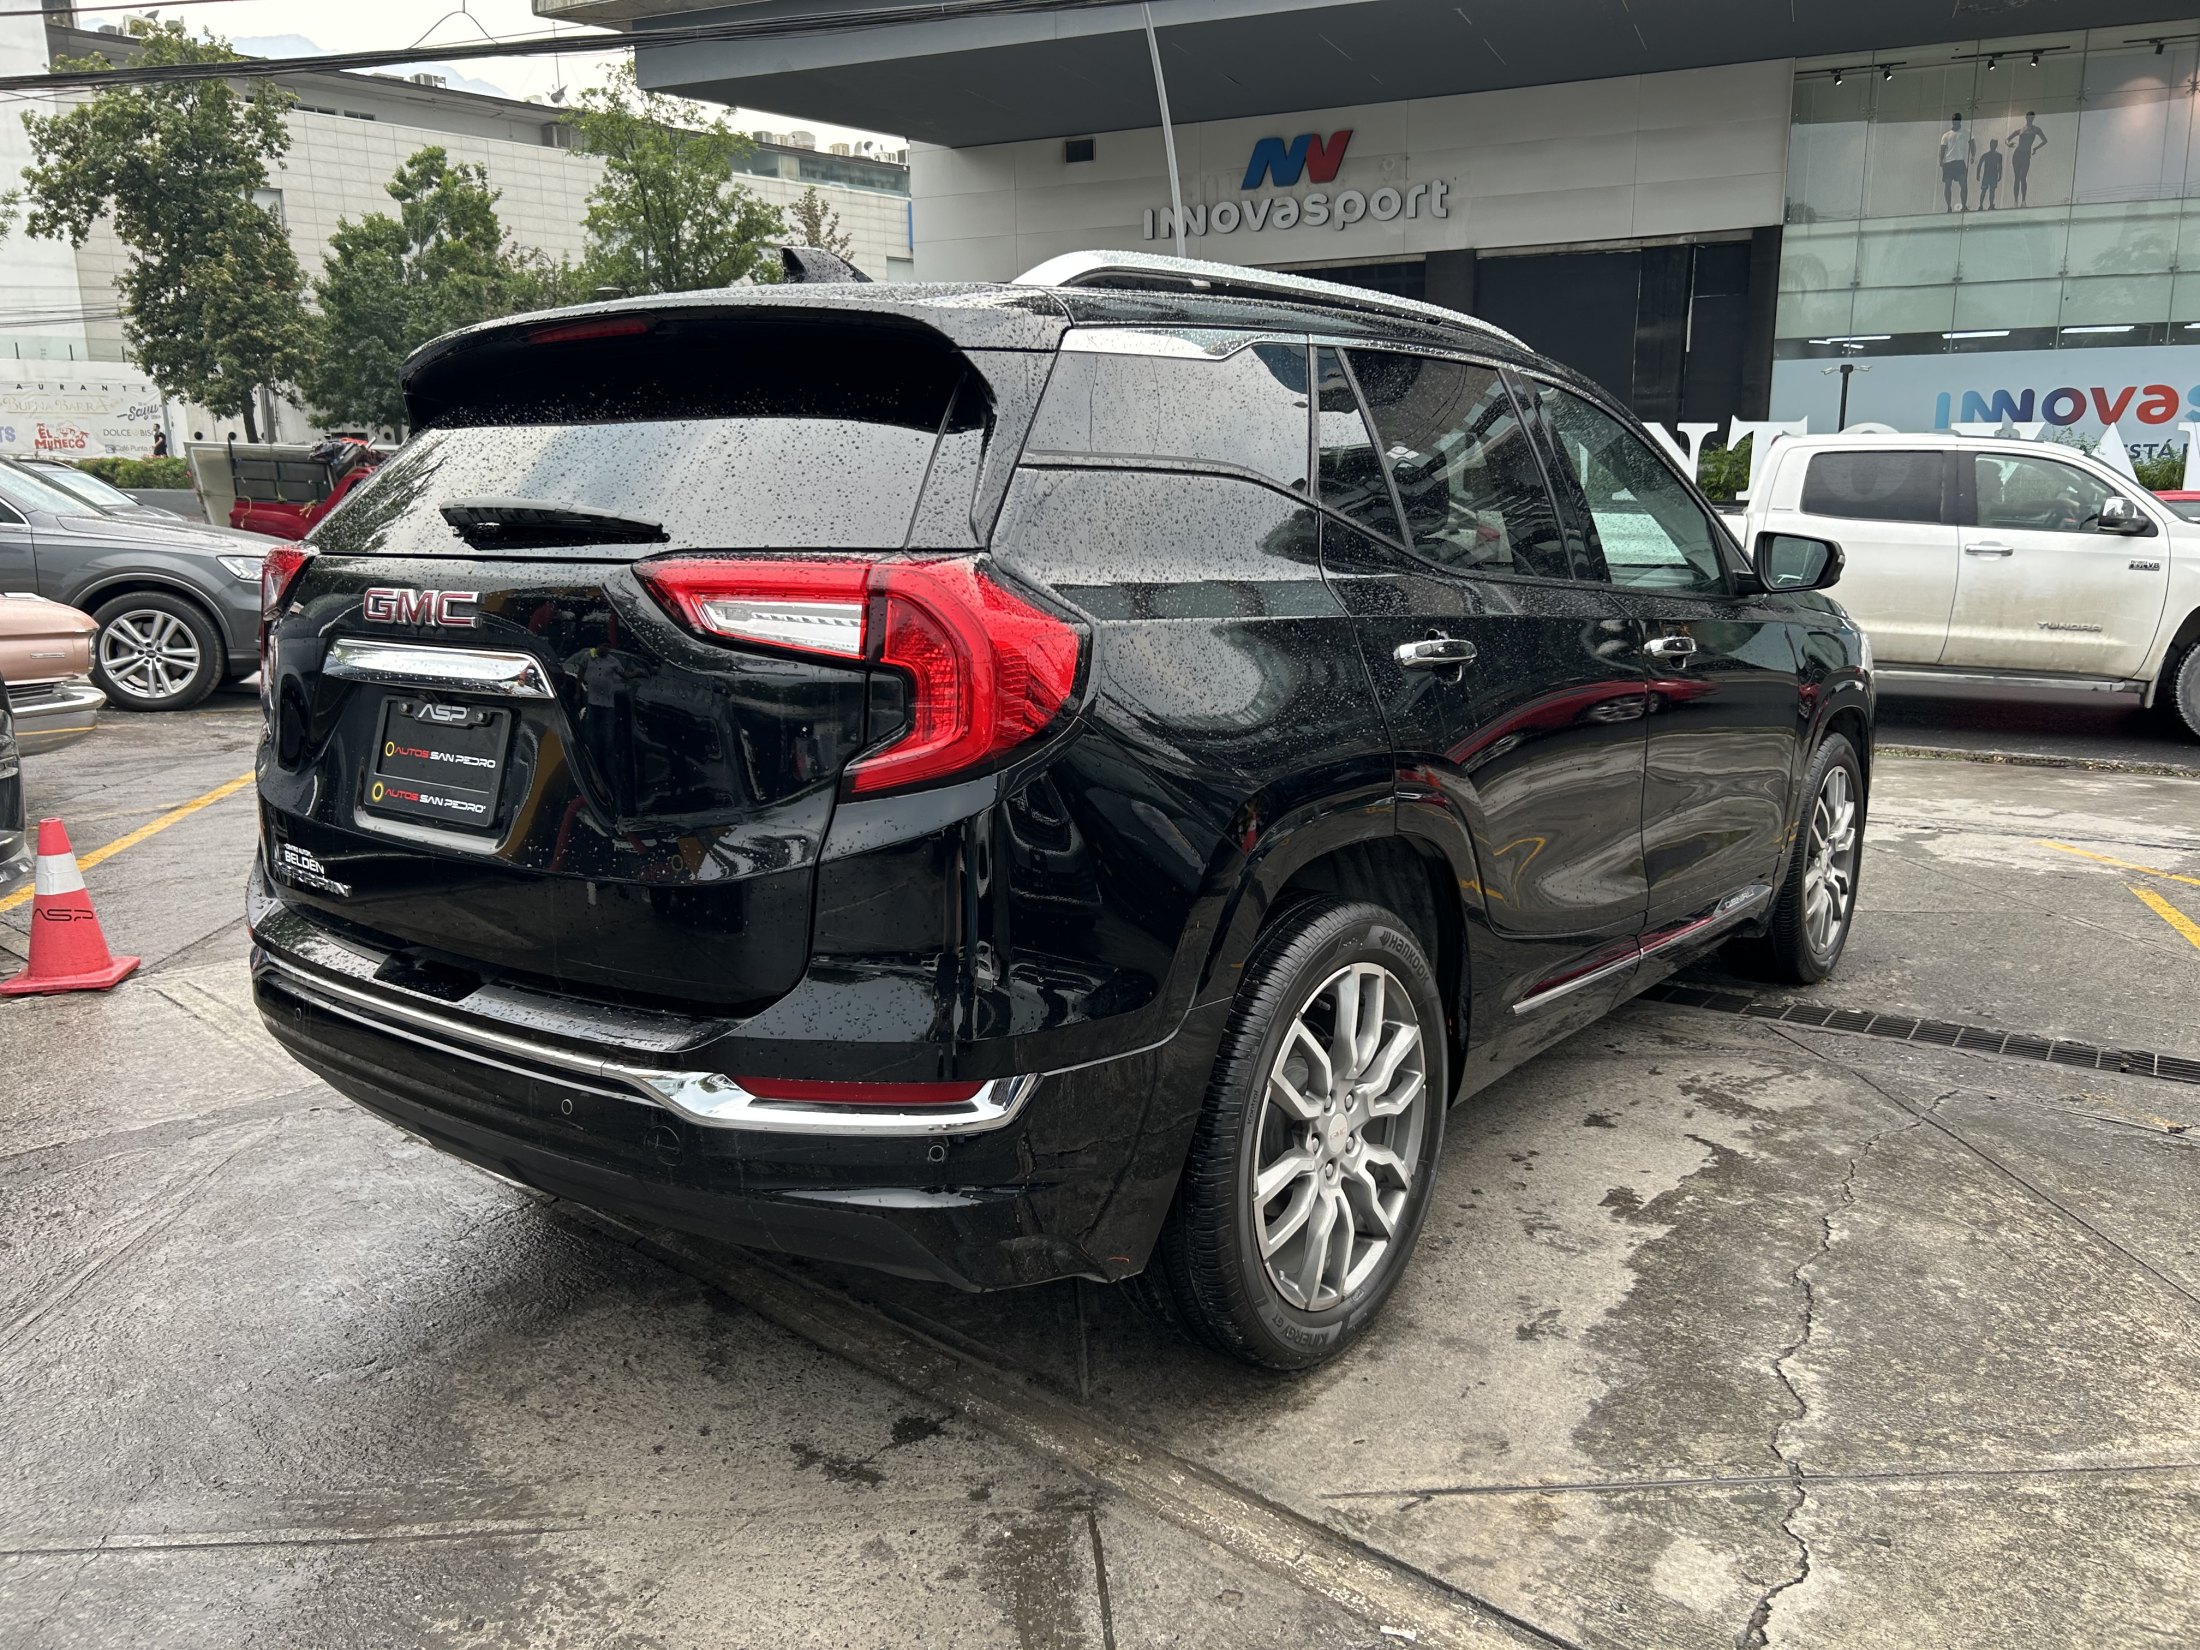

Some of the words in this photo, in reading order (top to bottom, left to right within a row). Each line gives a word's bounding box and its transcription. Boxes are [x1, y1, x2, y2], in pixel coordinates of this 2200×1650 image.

[37, 423, 53, 439] EL
[103, 428, 132, 436] DOLCE
[363, 588, 480, 628] GMC
[2037, 620, 2103, 632] TUNDRA
[418, 703, 468, 721] ASP
[394, 746, 430, 758] AUTOS
[430, 751, 454, 762] SAN
[455, 755, 496, 769] PEDRO
[384, 788, 420, 801] AUTOS
[420, 794, 444, 806] SAN
[444, 799, 483, 813] PEDRO
[285, 850, 325, 874] BELDEN
[33, 907, 94, 921] ASP
